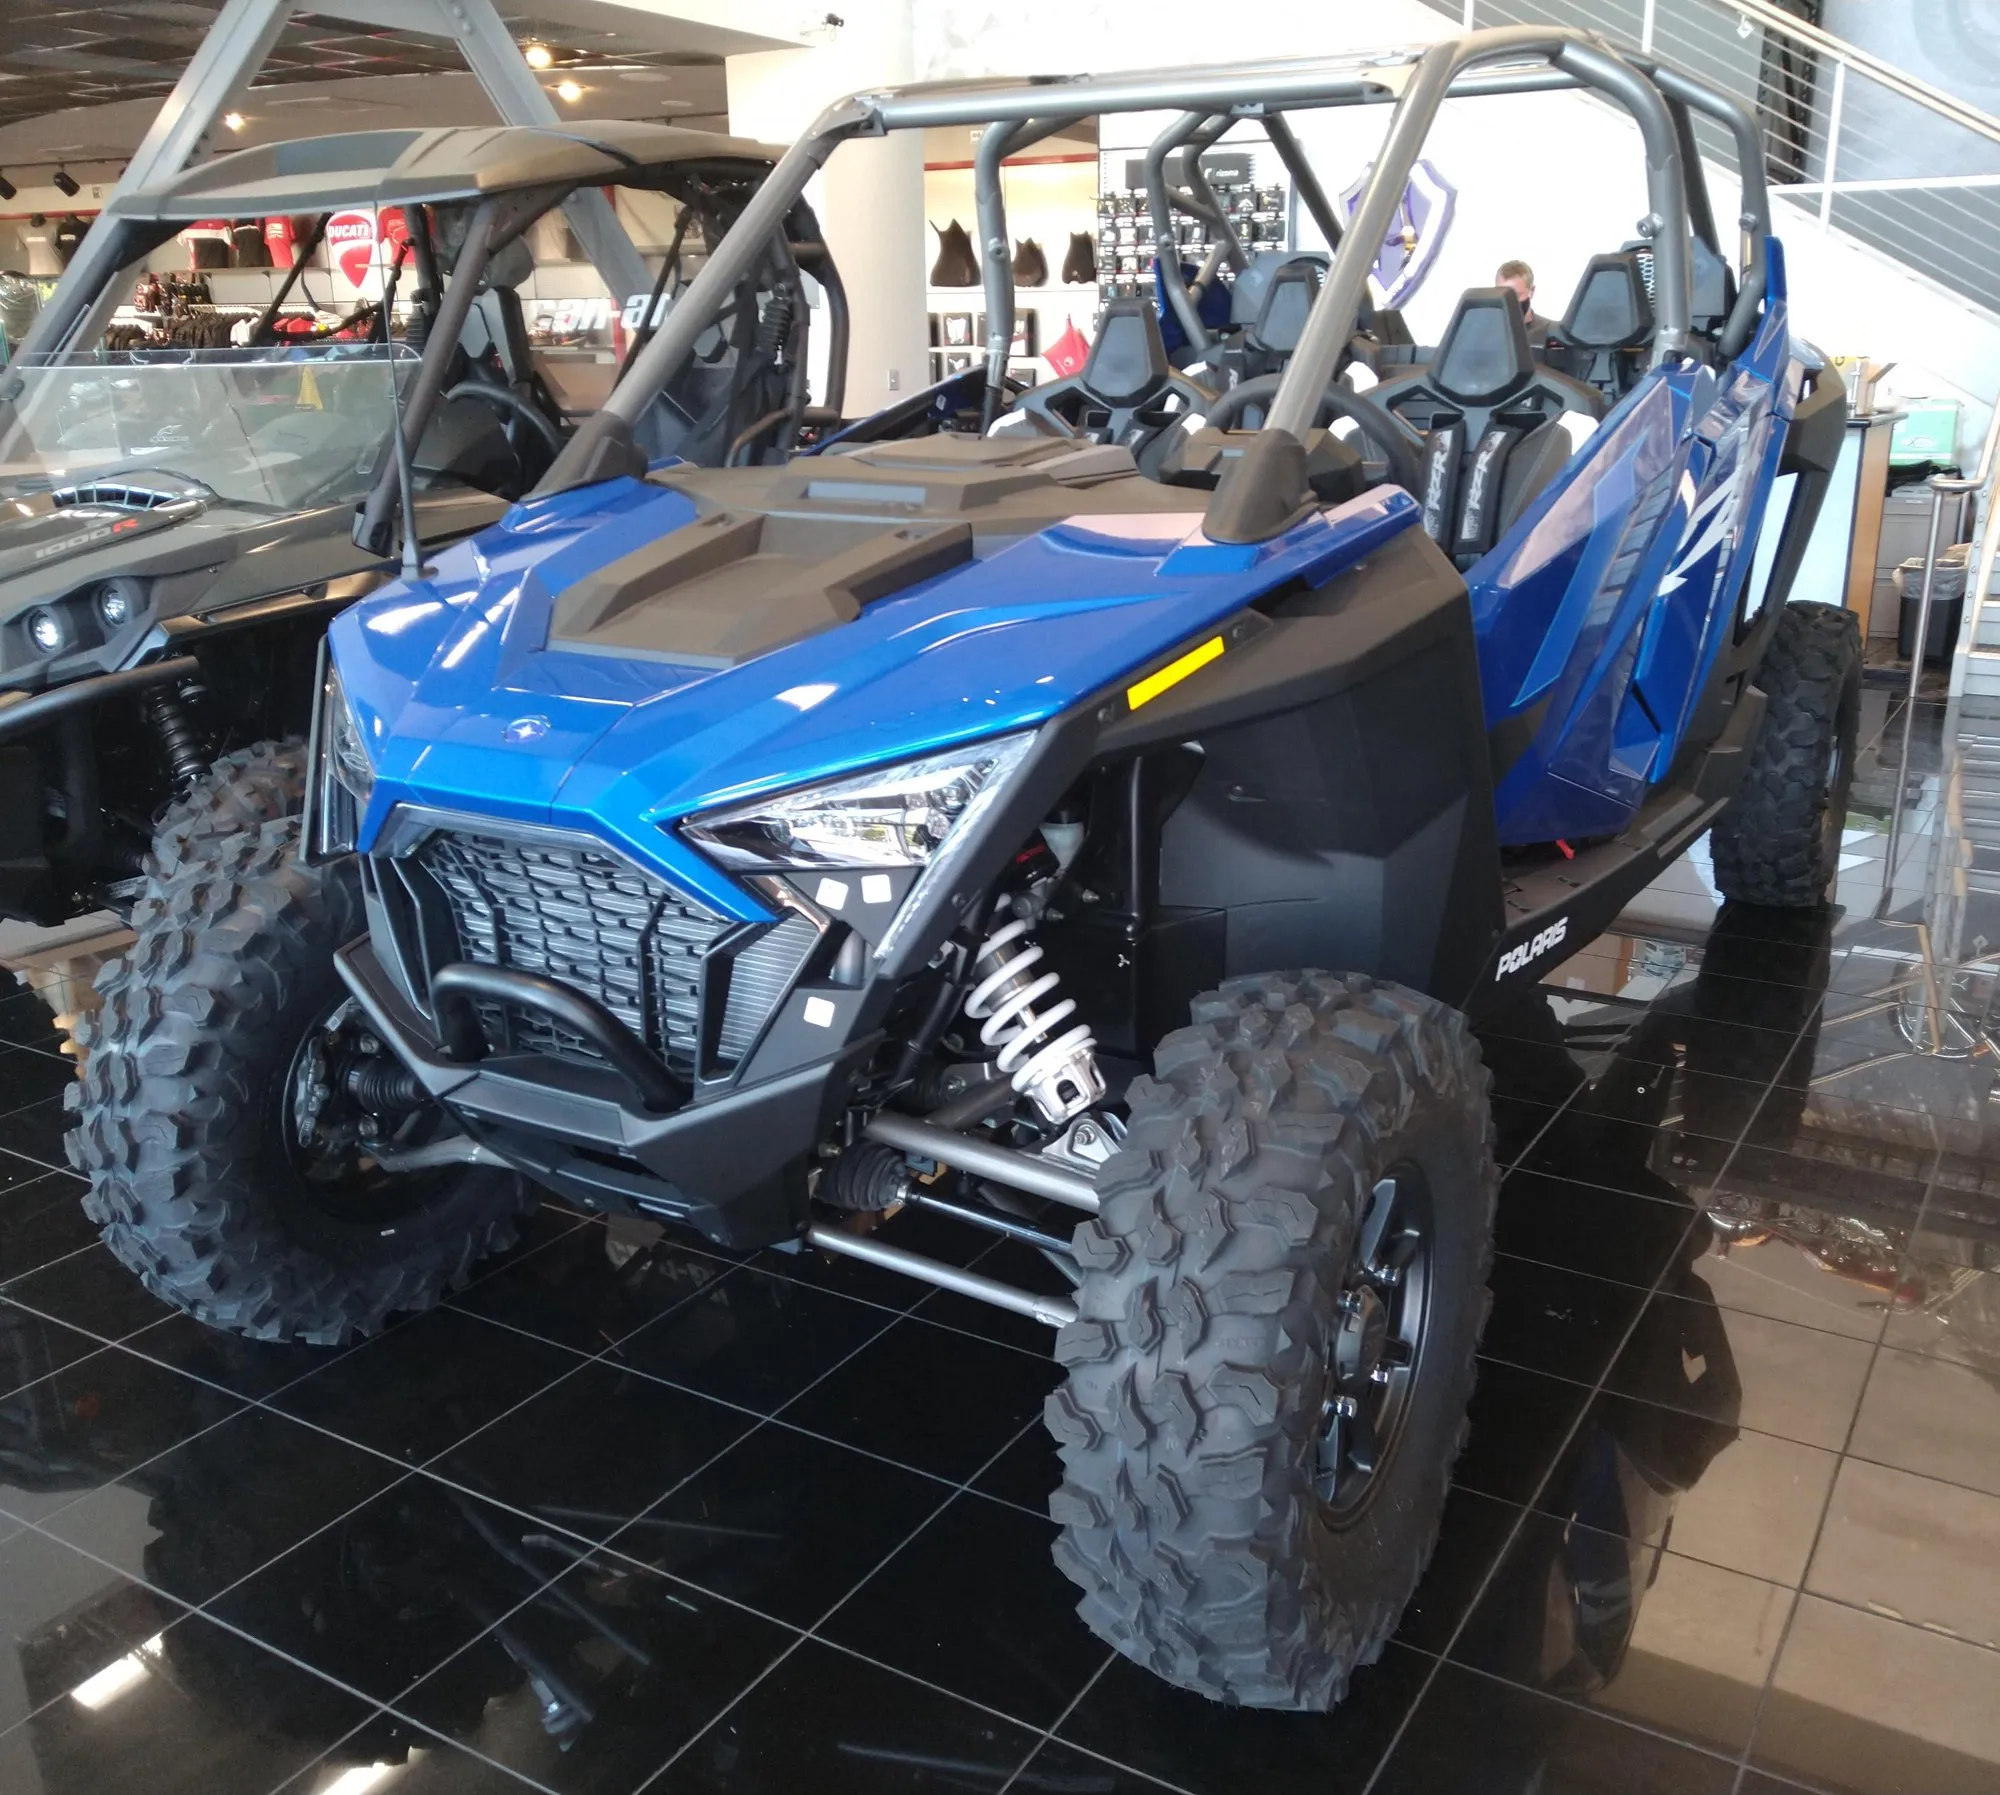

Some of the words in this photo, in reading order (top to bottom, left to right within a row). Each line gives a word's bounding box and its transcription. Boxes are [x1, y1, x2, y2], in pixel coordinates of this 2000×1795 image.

[328, 221, 370, 238] DUCATI
[1467, 450, 1493, 510] RZR
[35, 518, 138, 559] 1000R
[1495, 916, 1568, 981] POLARIS
